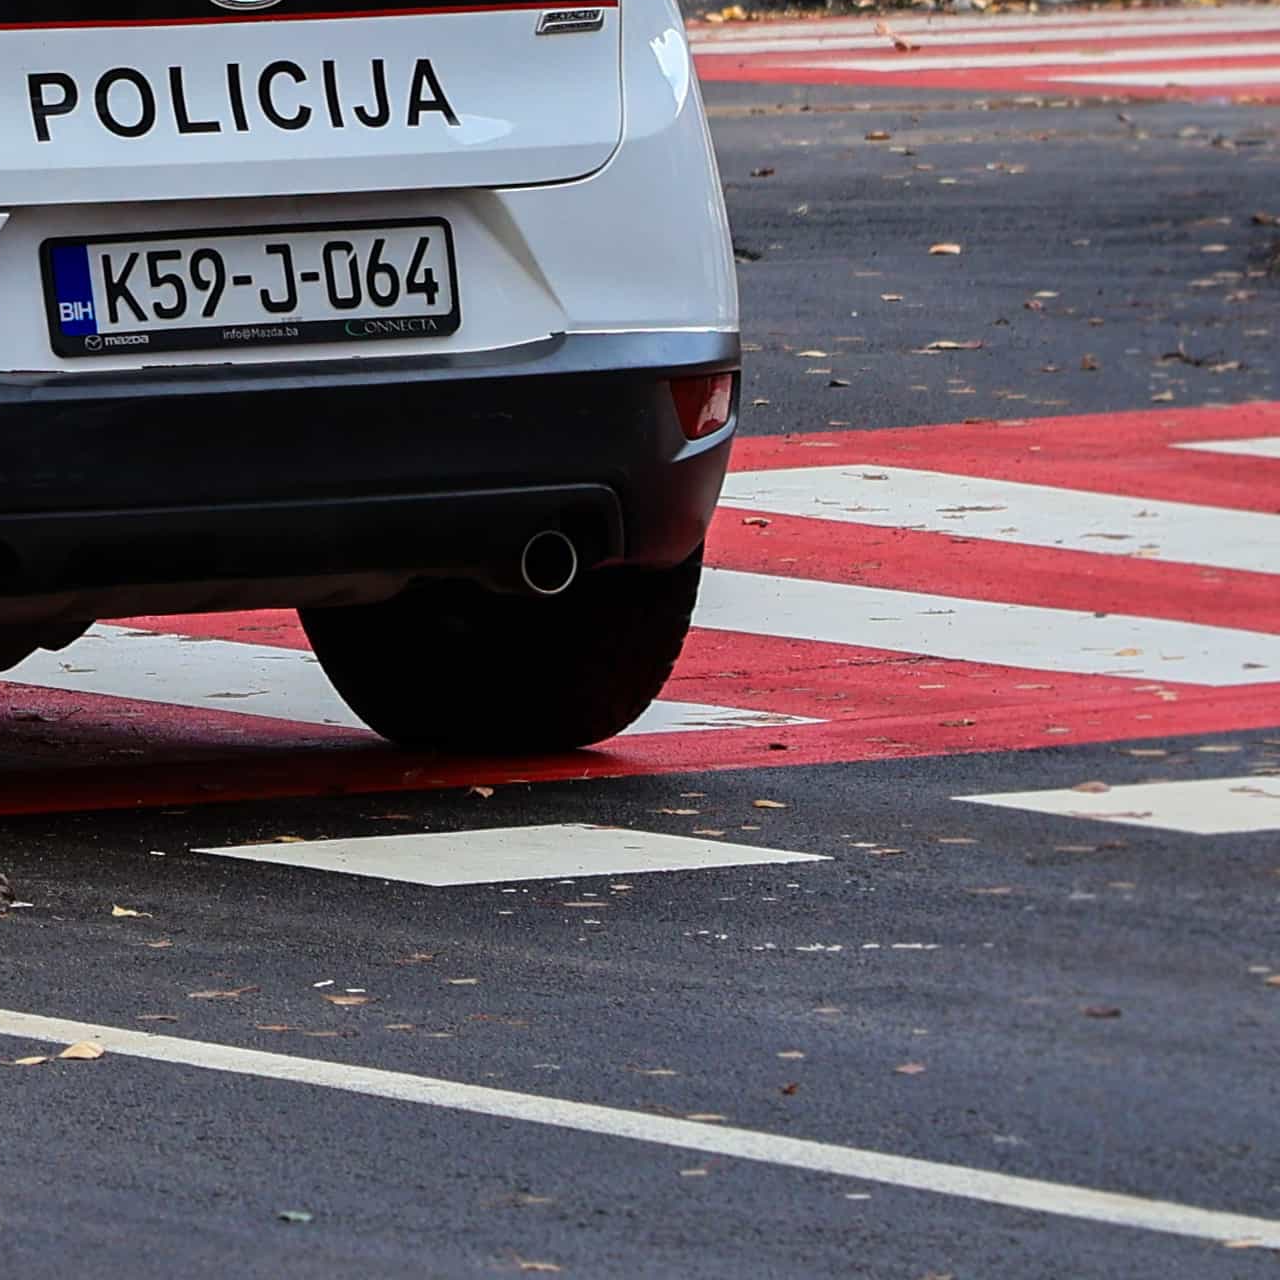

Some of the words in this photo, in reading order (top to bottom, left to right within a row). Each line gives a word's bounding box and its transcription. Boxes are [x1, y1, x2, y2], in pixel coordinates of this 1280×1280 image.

[27, 58, 460, 142] POLICIJA
[101, 236, 439, 324] K59-J-064
[58, 301, 94, 323] BIH
[104, 334, 150, 347] mazda
